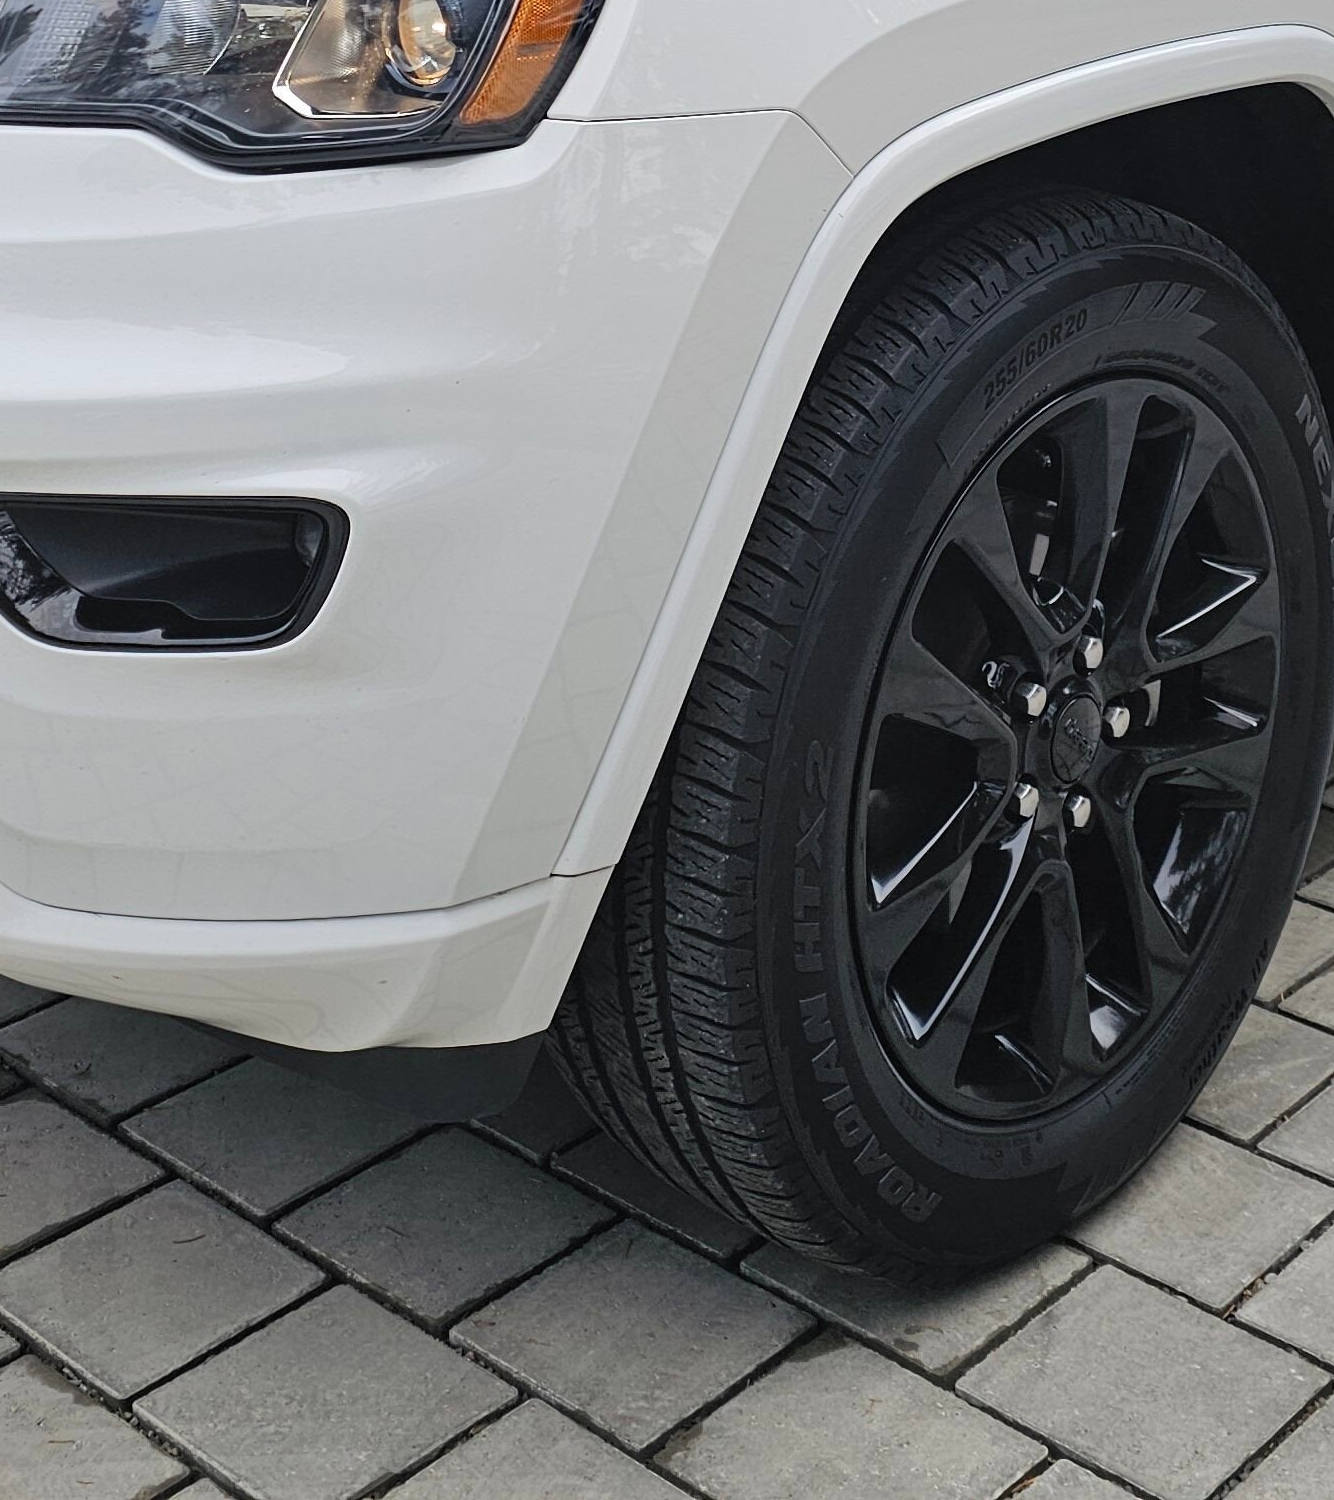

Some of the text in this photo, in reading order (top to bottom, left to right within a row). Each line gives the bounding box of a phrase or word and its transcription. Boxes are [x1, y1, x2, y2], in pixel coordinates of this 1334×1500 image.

[983, 308, 1088, 411] 255/60R20
[793, 739, 943, 1223] ROADIAN HTX2
